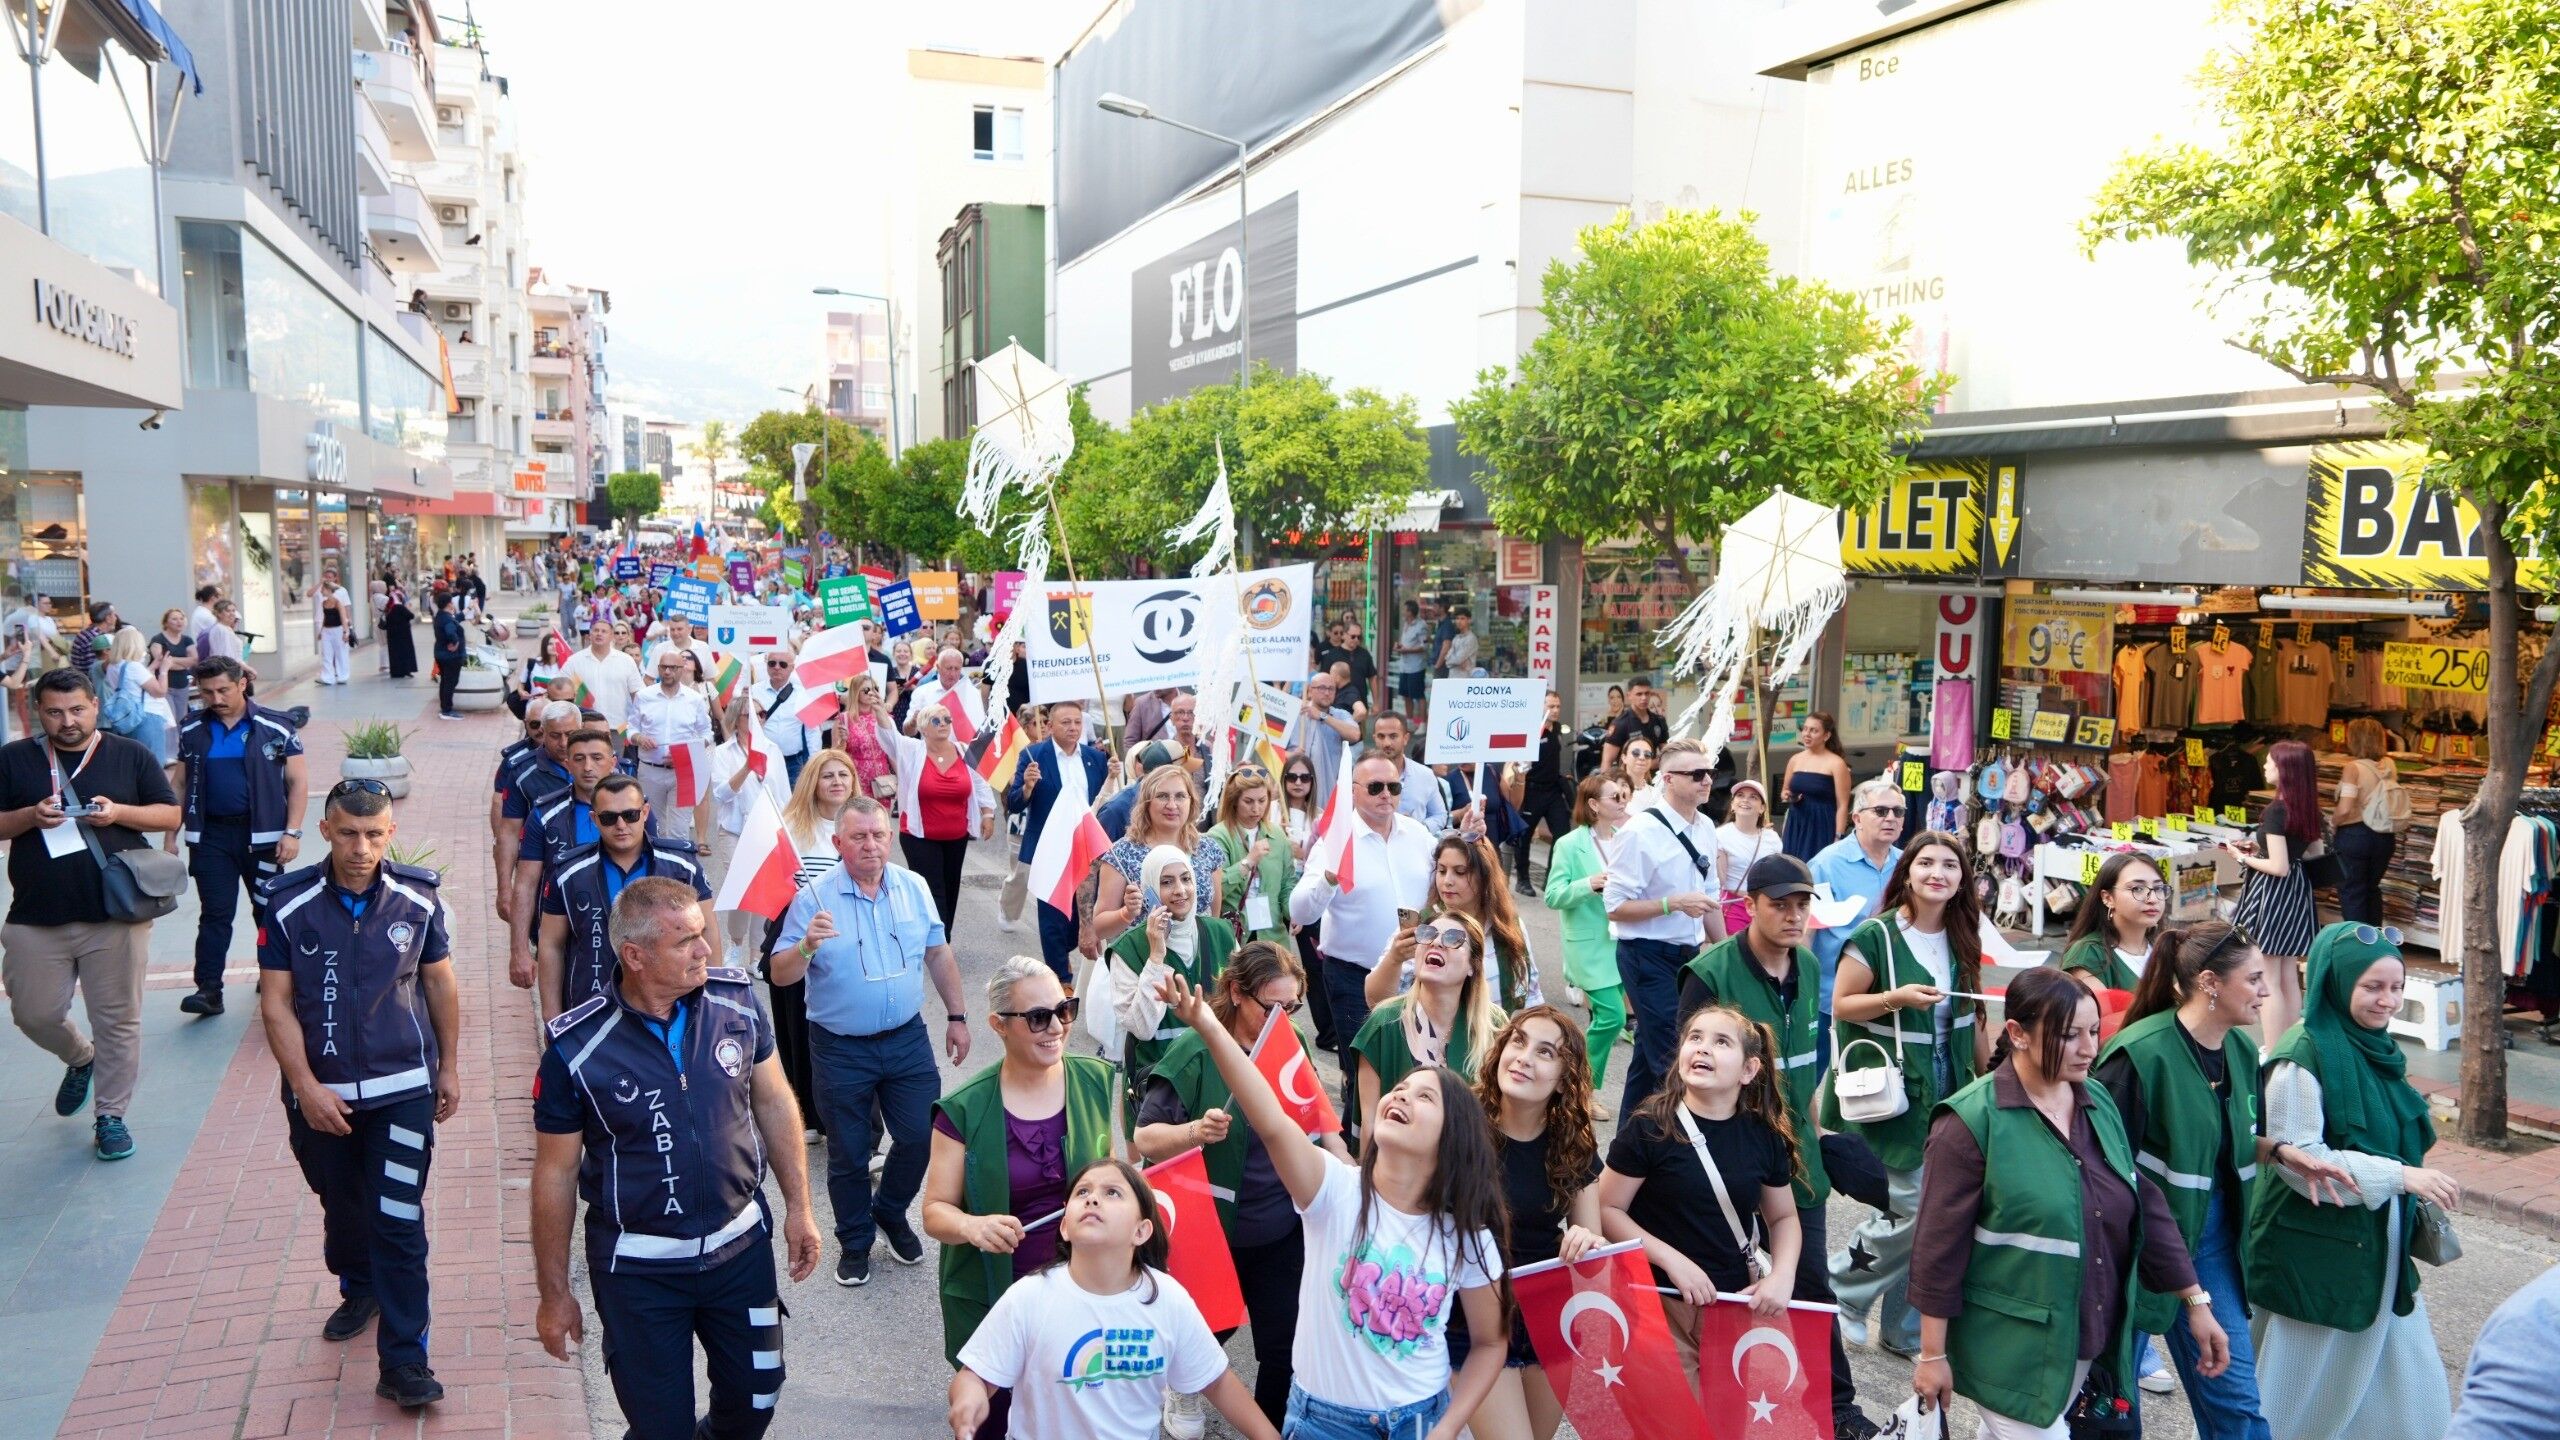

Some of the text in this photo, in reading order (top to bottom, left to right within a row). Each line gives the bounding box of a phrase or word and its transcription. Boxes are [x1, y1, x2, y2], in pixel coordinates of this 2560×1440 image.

[1844, 157, 1914, 195] ALLES
[1169, 247, 1243, 349] FLO
[1998, 473, 2012, 543] SALE
[1031, 654, 1111, 669] FREUNDESKEIS
[1032, 668, 1096, 679] GLADBECK-ALANY
[1466, 686, 1512, 695] POLONYA
[1262, 692, 1287, 708] ADBECK
[591, 906, 603, 992] ZABITA
[322, 950, 339, 1057] ZABITA
[644, 1089, 684, 1216] ZABITA
[1105, 1329, 1154, 1342] SURF
[1105, 1344, 1149, 1357] LIFE
[1105, 1356, 1165, 1372] LAUGH
